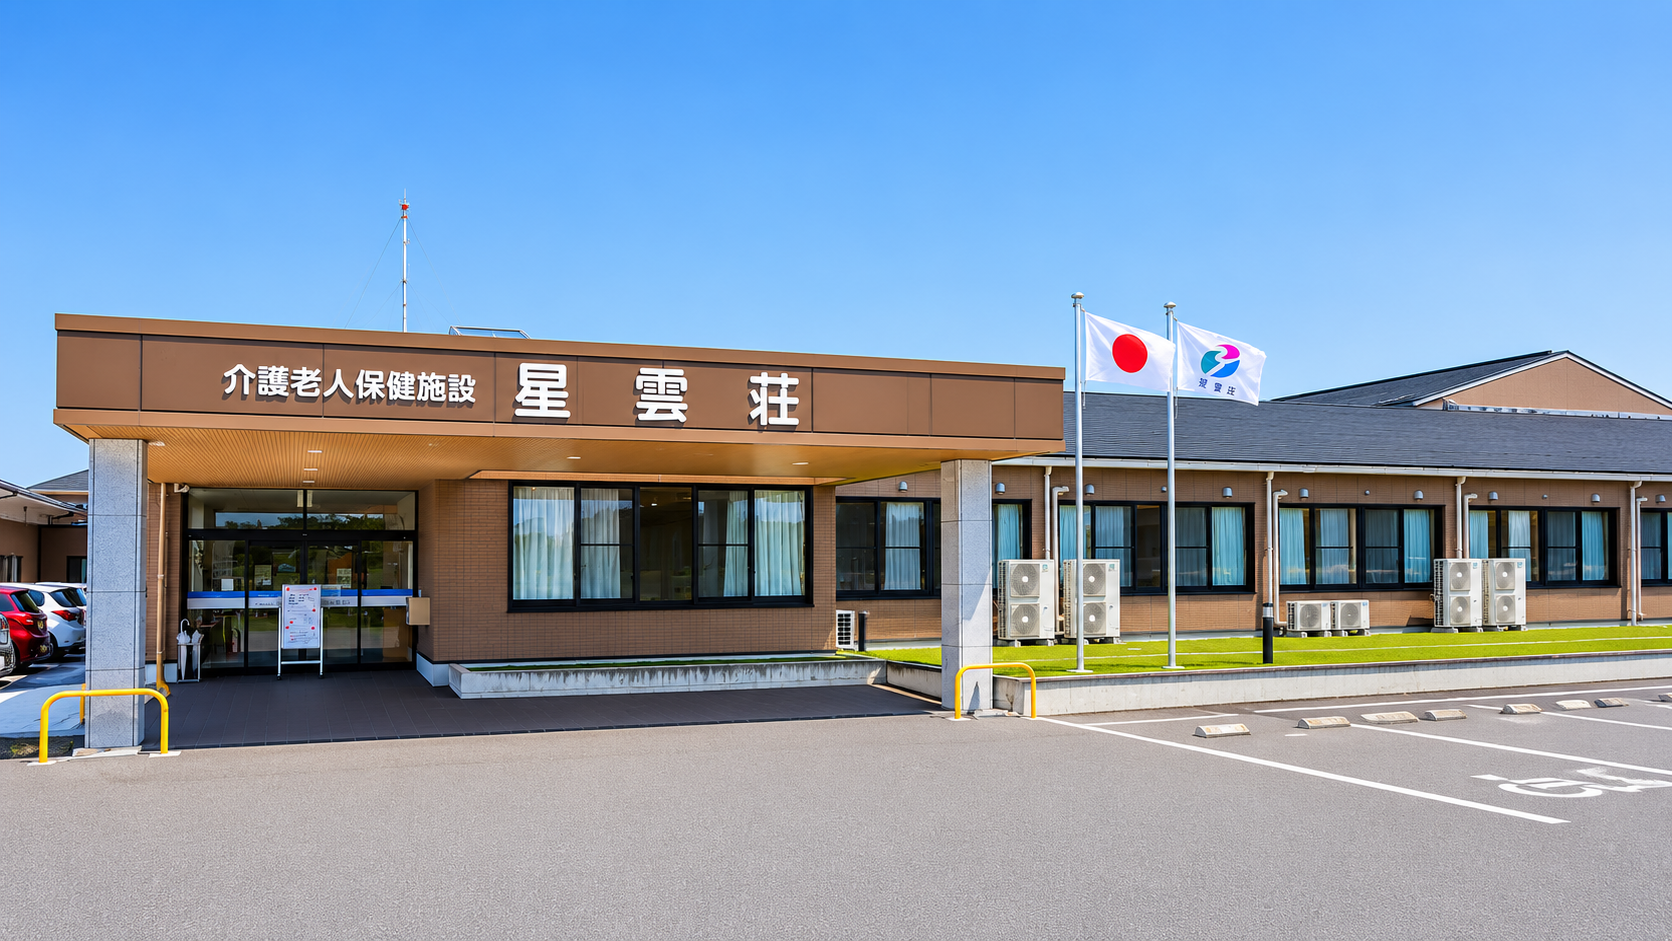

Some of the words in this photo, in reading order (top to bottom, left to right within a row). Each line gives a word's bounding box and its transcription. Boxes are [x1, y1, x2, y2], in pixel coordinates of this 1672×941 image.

[223, 363, 476, 403] 介護老人保健施設
